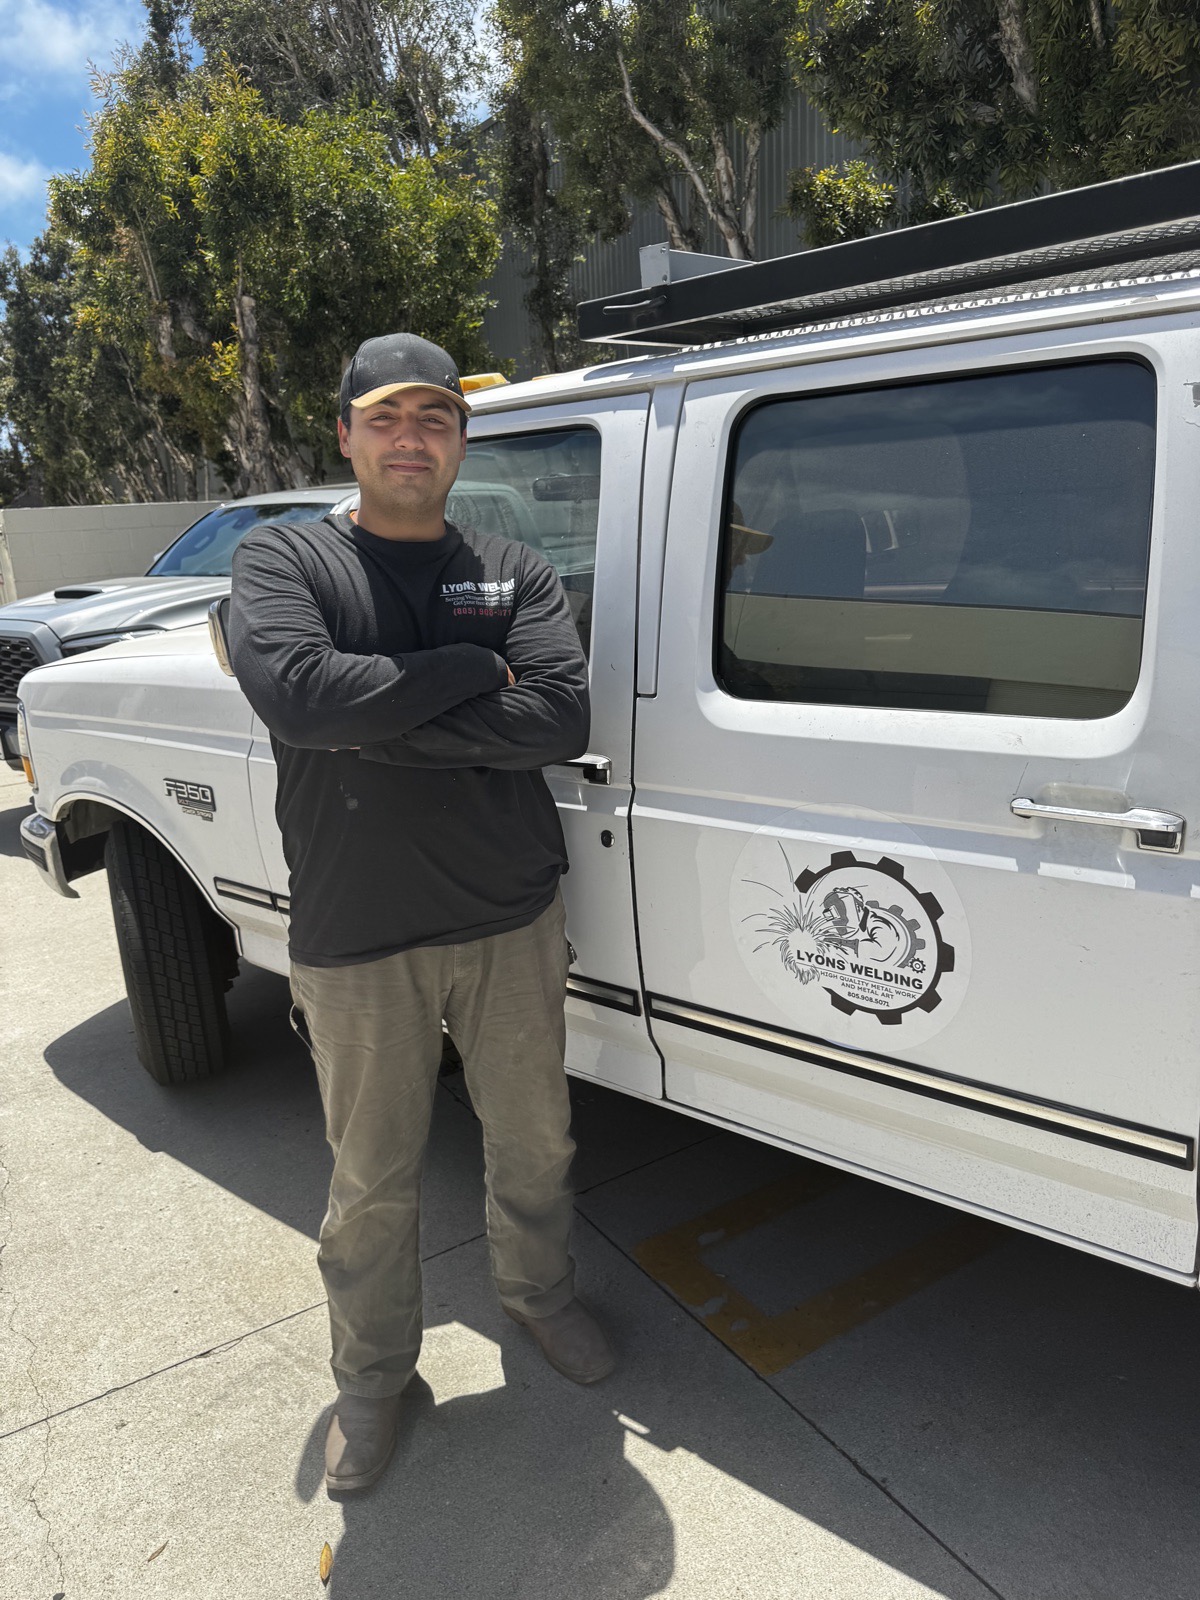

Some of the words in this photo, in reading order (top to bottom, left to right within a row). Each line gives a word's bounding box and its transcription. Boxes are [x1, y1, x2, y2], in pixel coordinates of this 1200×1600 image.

[442, 581, 476, 593] LYONS
[477, 578, 515, 592] WELIN
[453, 607, 476, 616] (805)
[163, 780, 212, 802] F350
[796, 949, 846, 971] LYONS
[850, 962, 923, 990] WELDING
[820, 971, 838, 980] HIGH
[839, 975, 869, 988] QUALITY
[870, 983, 893, 993] METAL
[894, 990, 917, 999] WORK
[841, 982, 855, 990] AND
[857, 986, 879, 996] METAL
[880, 991, 895, 999] ART
[847, 991, 890, 1007] 805.908.5071
